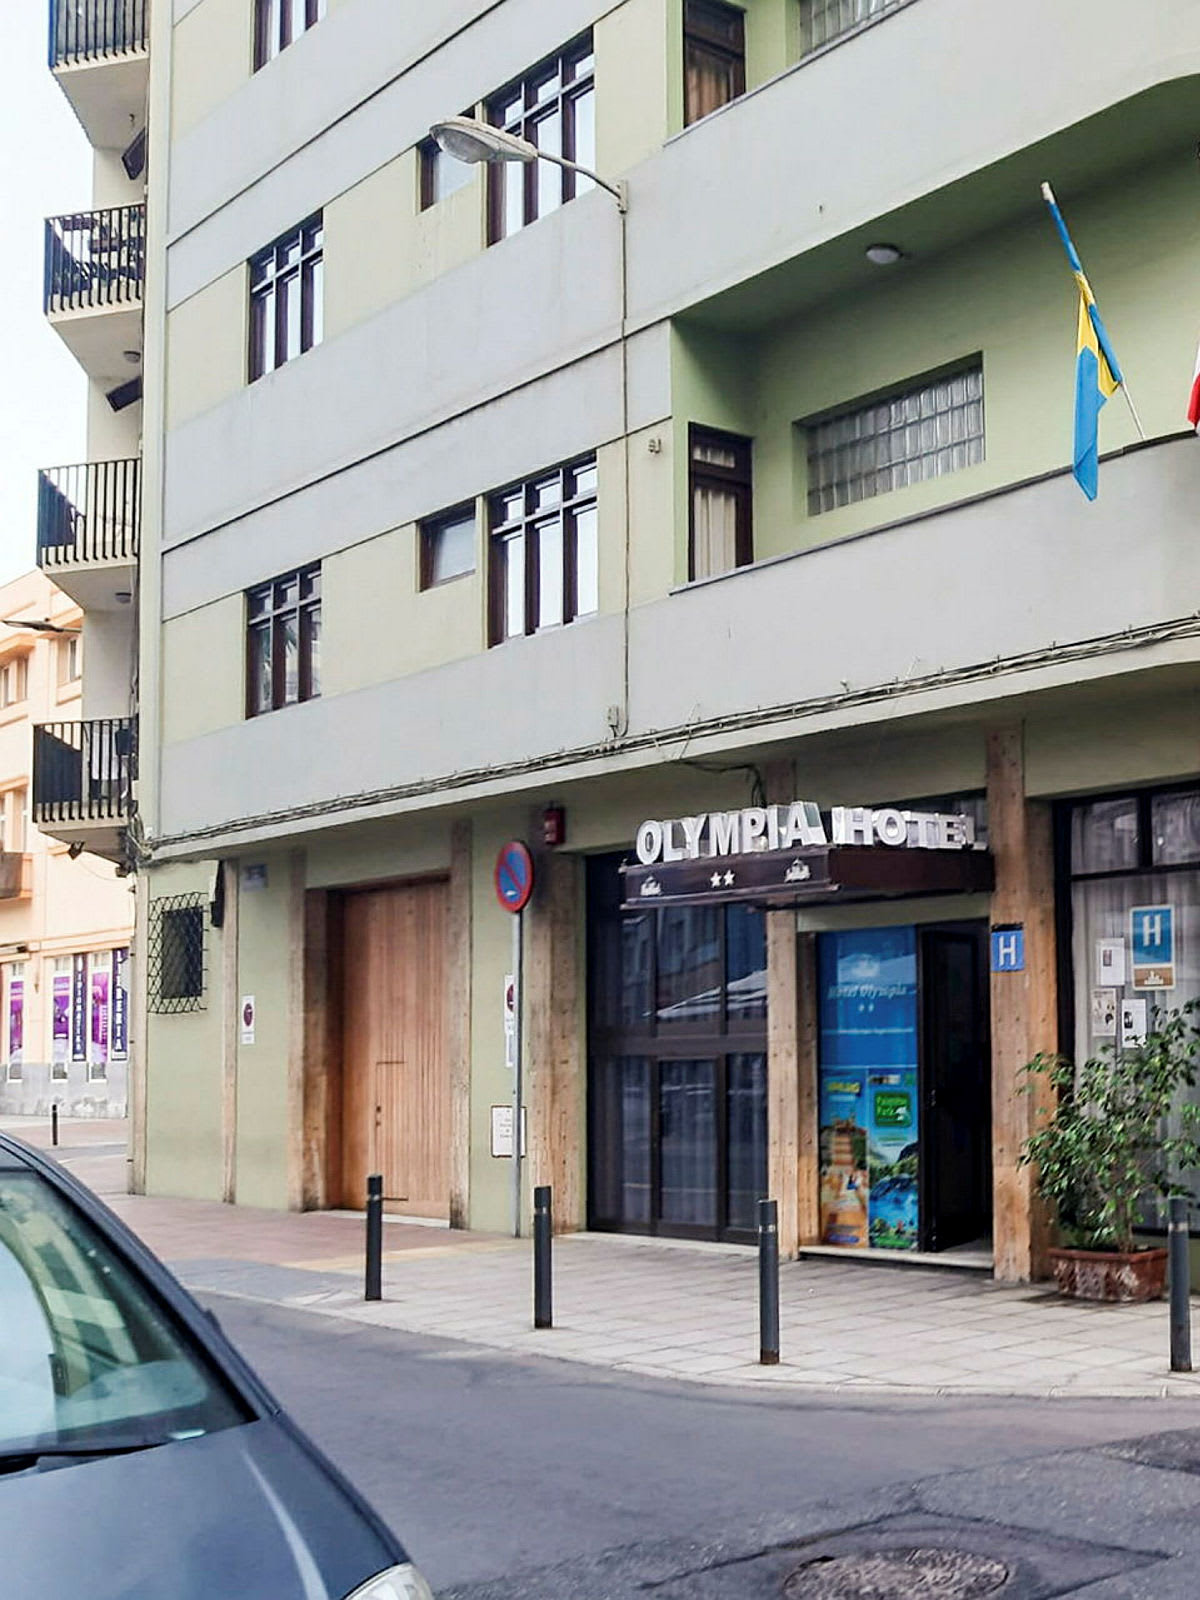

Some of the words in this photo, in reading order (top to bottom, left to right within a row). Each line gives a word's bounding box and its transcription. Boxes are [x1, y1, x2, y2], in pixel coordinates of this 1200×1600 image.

[636, 801, 828, 864] OLYMPIA
[831, 806, 987, 849] HOTEL
[1142, 914, 1162, 947] H
[998, 935, 1017, 967] H
